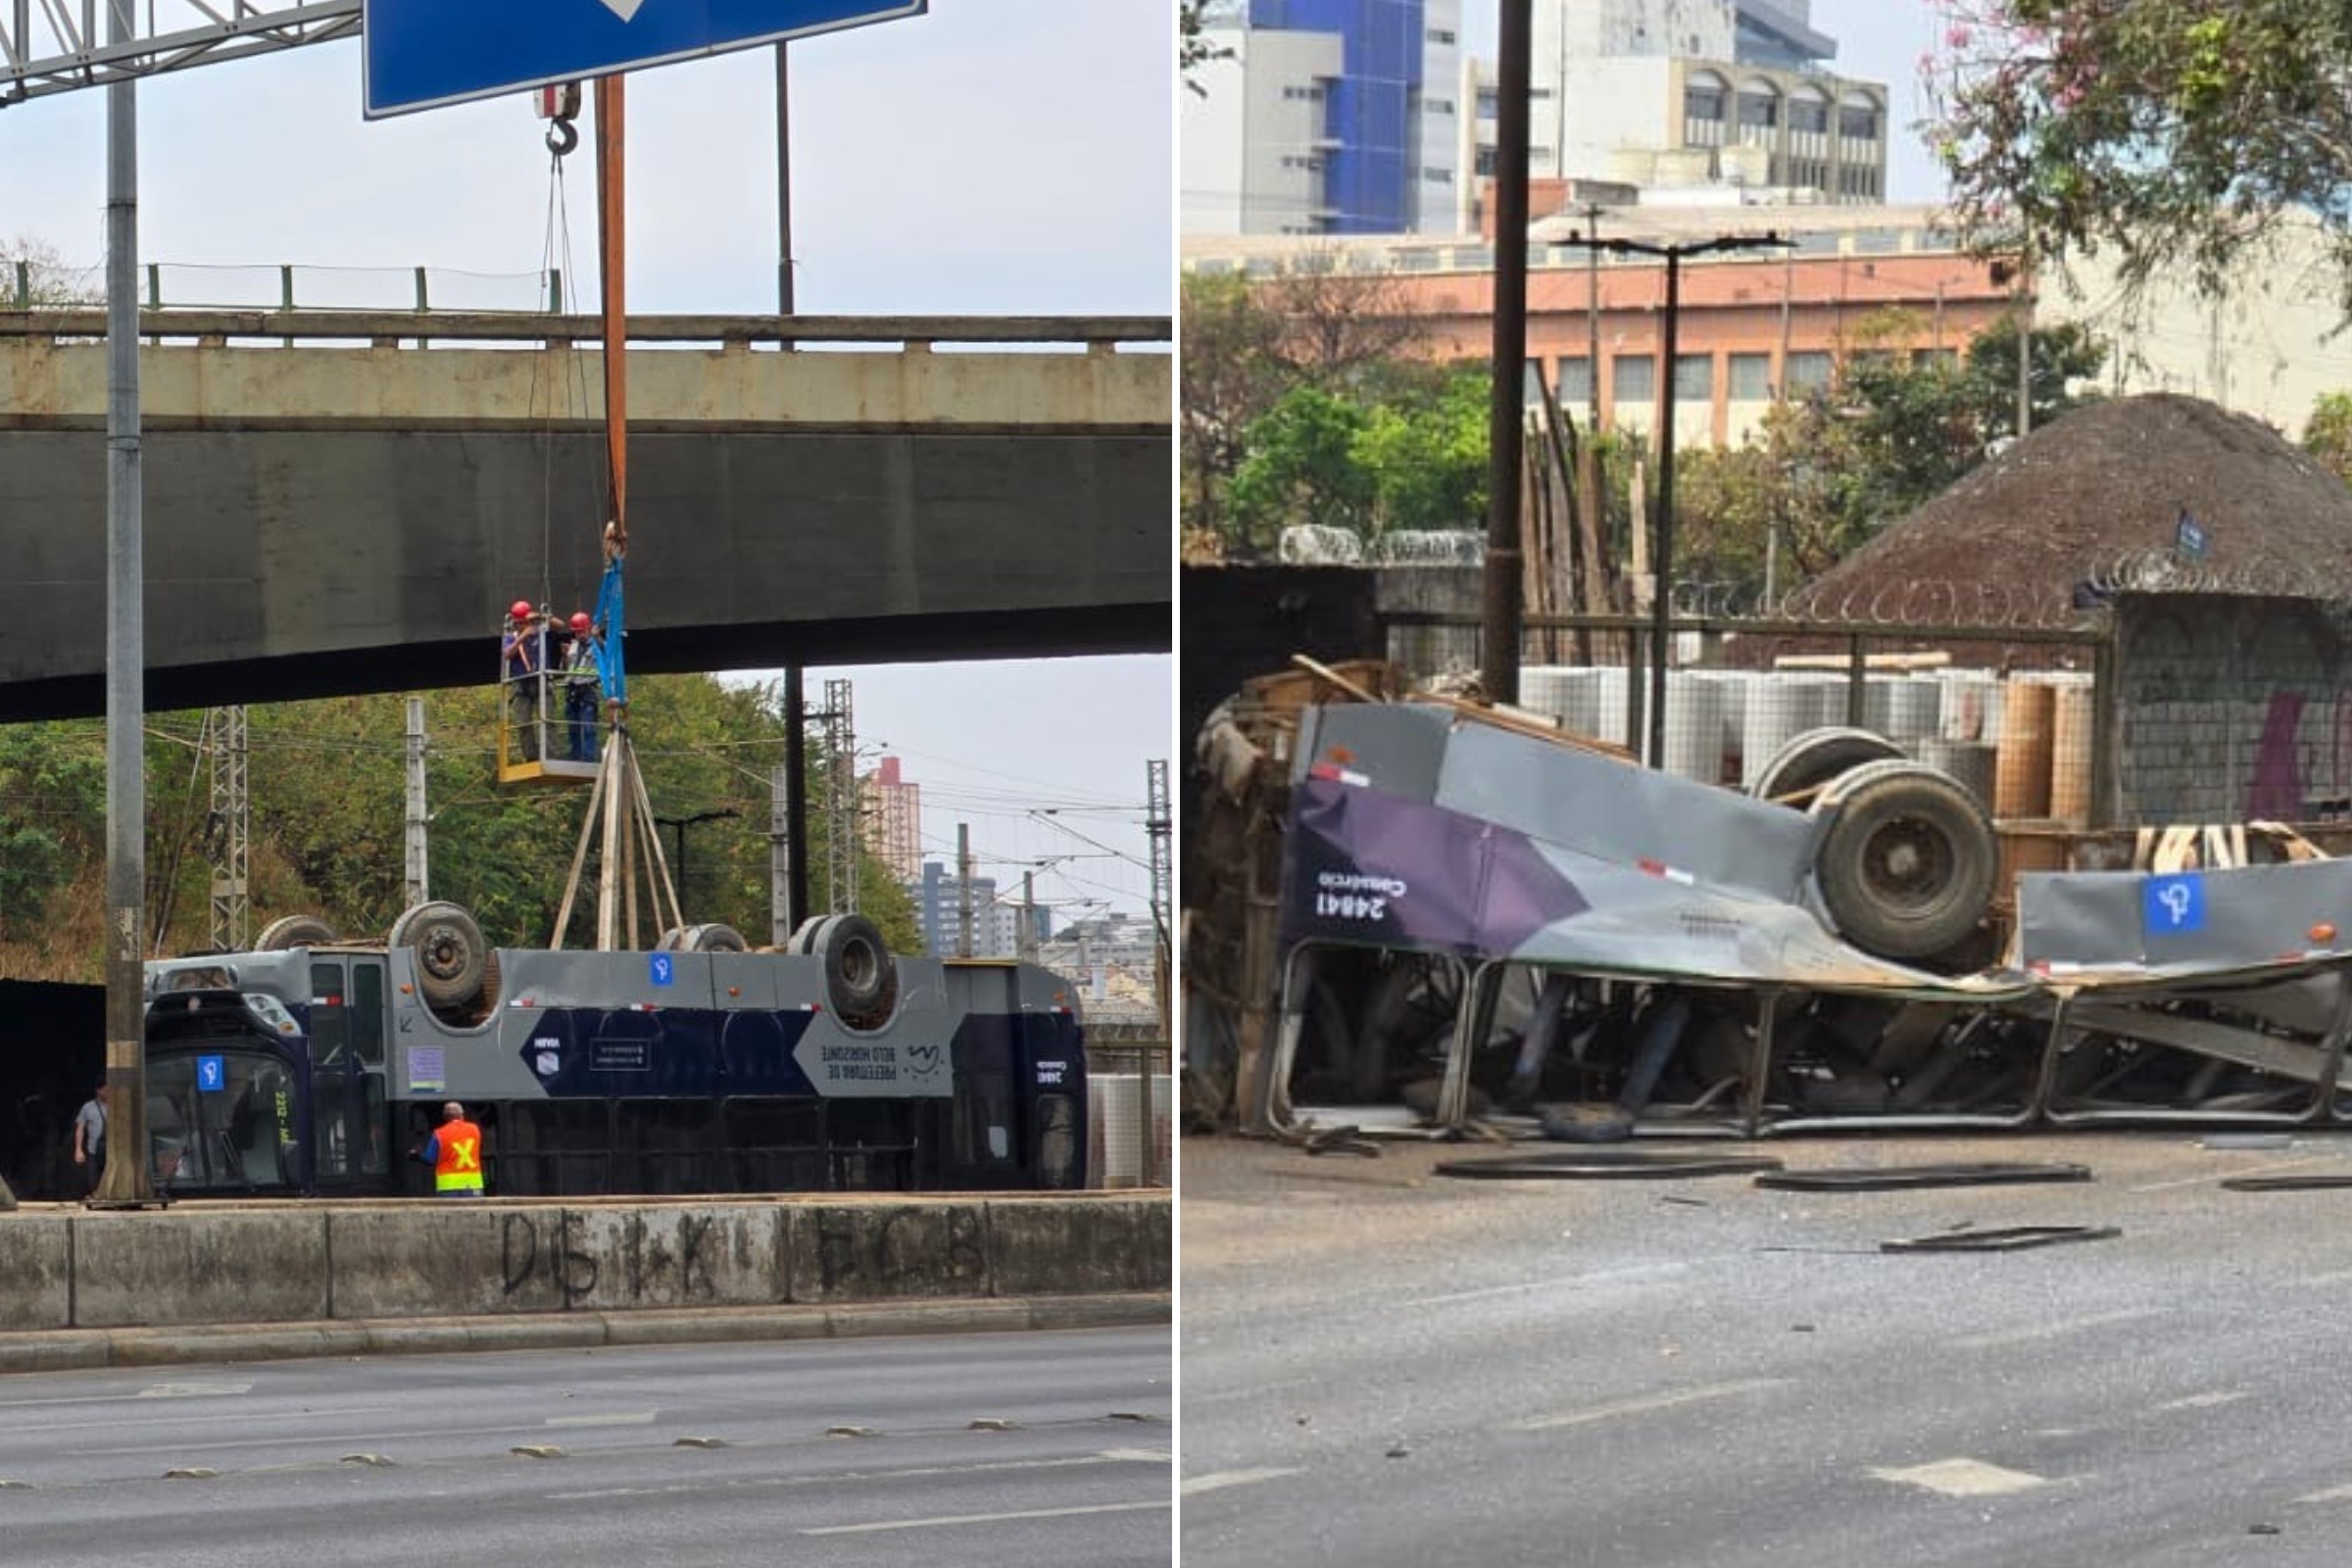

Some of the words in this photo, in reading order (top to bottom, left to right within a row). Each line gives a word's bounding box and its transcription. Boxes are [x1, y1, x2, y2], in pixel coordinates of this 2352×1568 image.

[1316, 893, 1387, 920] 24841
[821, 1046, 870, 1062] HORIZONTE
[872, 1046, 896, 1062] BELO
[828, 1064, 841, 1080] DE
[842, 1064, 897, 1080] PREFEITURA
